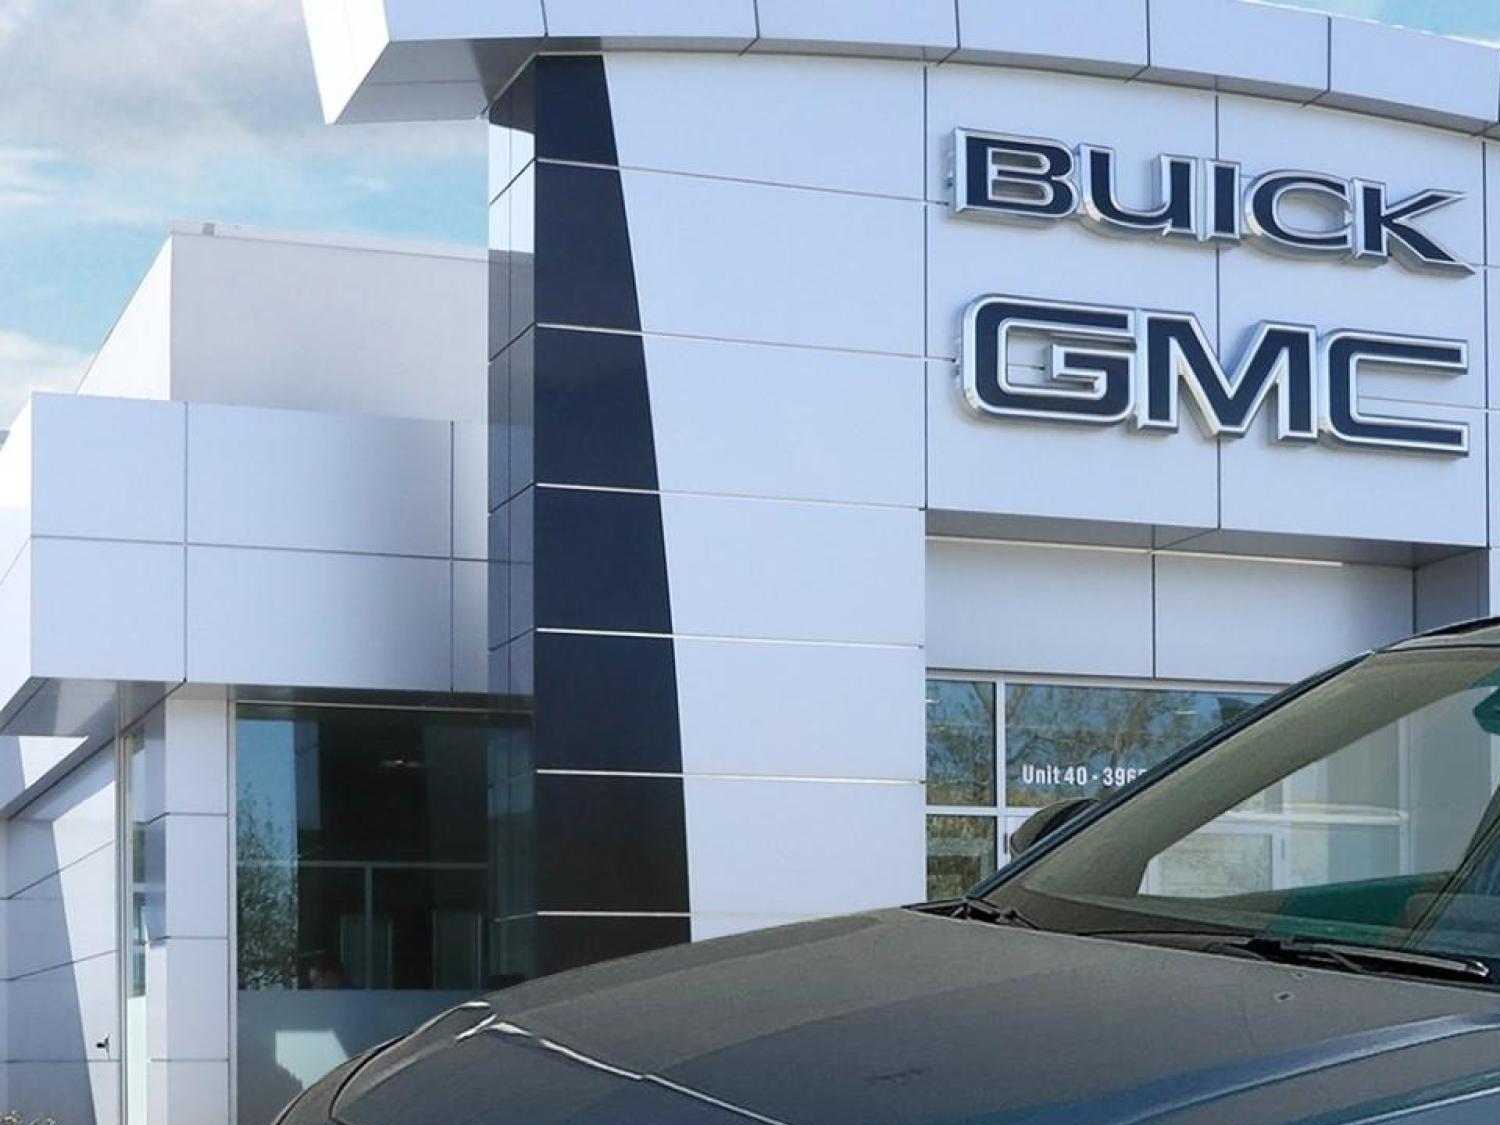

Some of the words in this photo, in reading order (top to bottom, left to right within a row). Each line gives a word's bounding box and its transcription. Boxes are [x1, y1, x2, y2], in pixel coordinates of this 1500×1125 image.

[949, 126, 1476, 277] BUICK
[959, 292, 1470, 457] GMC
[1022, 764, 1060, 785] Unit
[1063, 766, 1087, 786] 40
